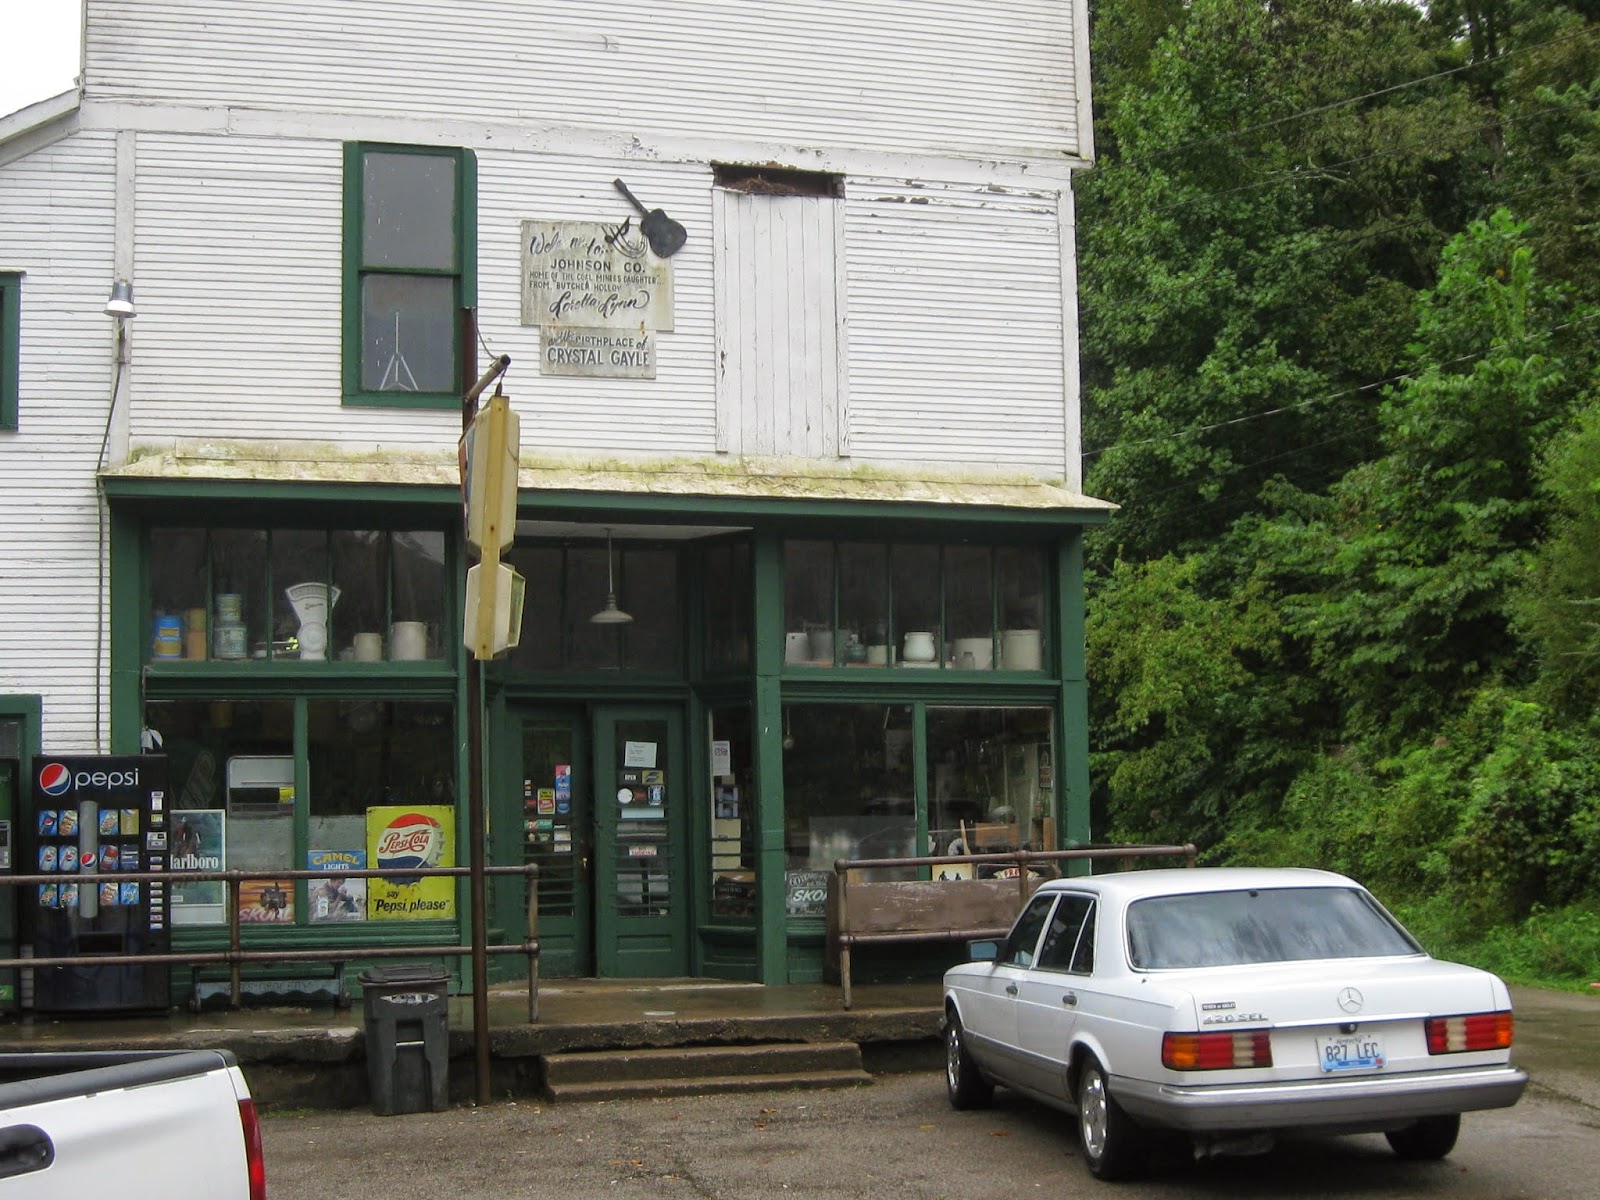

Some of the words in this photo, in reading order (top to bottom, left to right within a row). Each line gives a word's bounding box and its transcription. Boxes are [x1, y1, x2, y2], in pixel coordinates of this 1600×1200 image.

[551, 259, 611, 272] JOHNSON
[624, 262, 646, 273] CO.
[529, 271, 548, 279] HOME
[549, 291, 597, 319] Loretta
[598, 290, 650, 318] Lynn
[576, 336, 635, 348] BIRTHPLACE
[636, 336, 649, 350] of
[547, 347, 604, 365] CRYSTAL
[611, 350, 650, 367] GAYLE
[74, 767, 140, 791] pepsi
[312, 852, 360, 866] CAMEL
[323, 863, 350, 871] LIGHTS
[386, 891, 399, 899] say
[1325, 1045, 1348, 1062] 827
[1356, 1042, 1380, 1059] LEC
